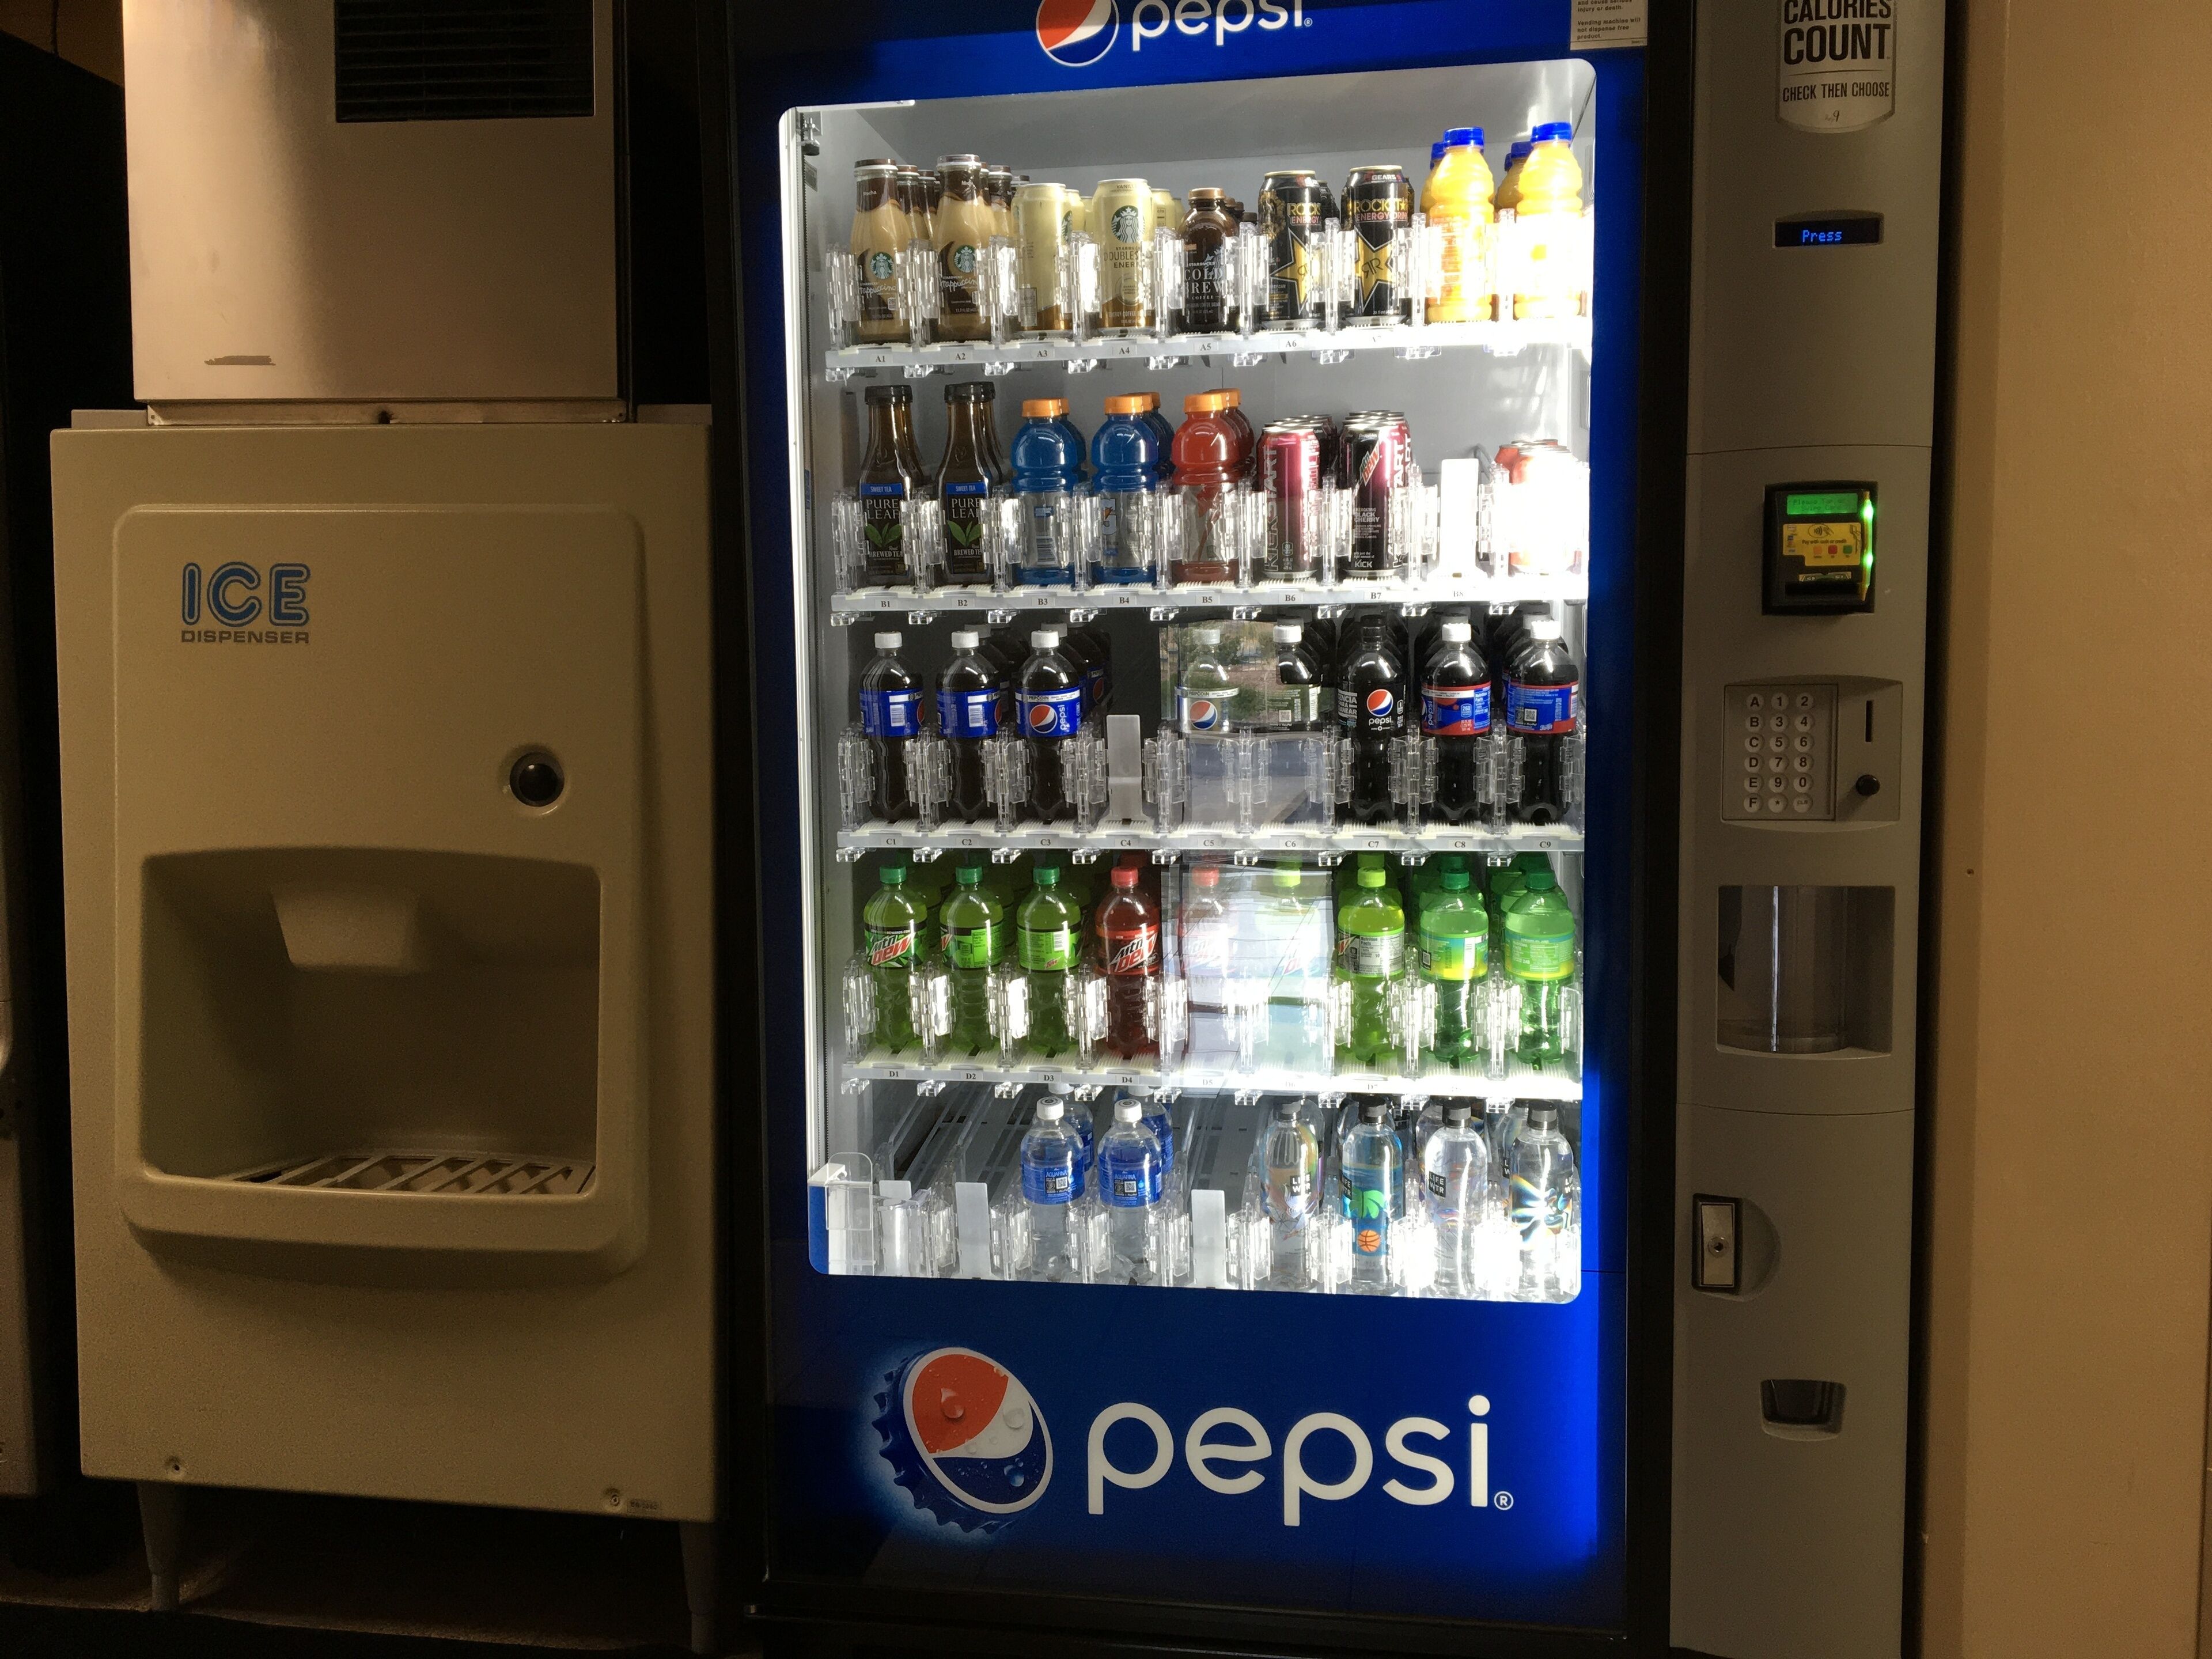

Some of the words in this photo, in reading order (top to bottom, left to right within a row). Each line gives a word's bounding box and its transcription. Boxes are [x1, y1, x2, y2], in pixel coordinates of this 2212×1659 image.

[1784, 0, 1891, 24] CALORIES
[1132, 0, 1302, 51] pepsi
[1784, 24, 1891, 65] COUNT
[1783, 85, 1816, 101] CHECK
[1821, 82, 1847, 98] THEN
[1851, 82, 1889, 97] CHOOSE
[1356, 212, 1389, 221] ENERGY
[1802, 230, 1842, 243] Press
[1104, 251, 1139, 262] DOUBLES
[1184, 268, 1223, 281] COLD
[1187, 281, 1224, 294] REW
[1199, 343, 1211, 351] A5
[866, 499, 899, 509] PURE
[867, 509, 899, 519] LEAF
[181, 561, 311, 627] ICE
[181, 630, 310, 644] DISPENSER
[1750, 696, 1759, 707] A
[1777, 696, 1782, 706] 1
[1801, 696, 1808, 706] 2
[1058, 704, 1067, 730] pepsi
[1368, 715, 1392, 726] pepsi
[1750, 717, 1759, 727] B
[1775, 717, 1783, 727] 3
[1800, 717, 1808, 726] 4
[1749, 737, 1758, 747] C
[1775, 737, 1782, 747] 5
[1800, 737, 1807, 747] 6
[1749, 757, 1758, 767] D
[1775, 757, 1782, 767] 7
[1799, 757, 1807, 767] 8
[1749, 777, 1757, 787] E
[1774, 777, 1782, 787] 9
[1799, 777, 1806, 787] 0
[1749, 797, 1757, 808] F
[886, 838, 896, 846] C1
[961, 838, 972, 846] C2
[1040, 838, 1051, 846] C3
[1120, 839, 1131, 847] C4
[1203, 839, 1215, 848] C5
[1285, 840, 1296, 848] C6
[1368, 840, 1380, 848] C7
[1454, 840, 1466, 849] C8
[1539, 840, 1551, 849] C9
[1043, 1074, 1055, 1082] D3
[1202, 1078, 1213, 1086] D5
[1293, 1173, 1311, 1184] LIE
[1429, 1173, 1445, 1185] LIFE
[1293, 1183, 1311, 1193] WR
[1429, 1182, 1445, 1194] WTR
[1088, 1395, 1491, 1527] pepsi
